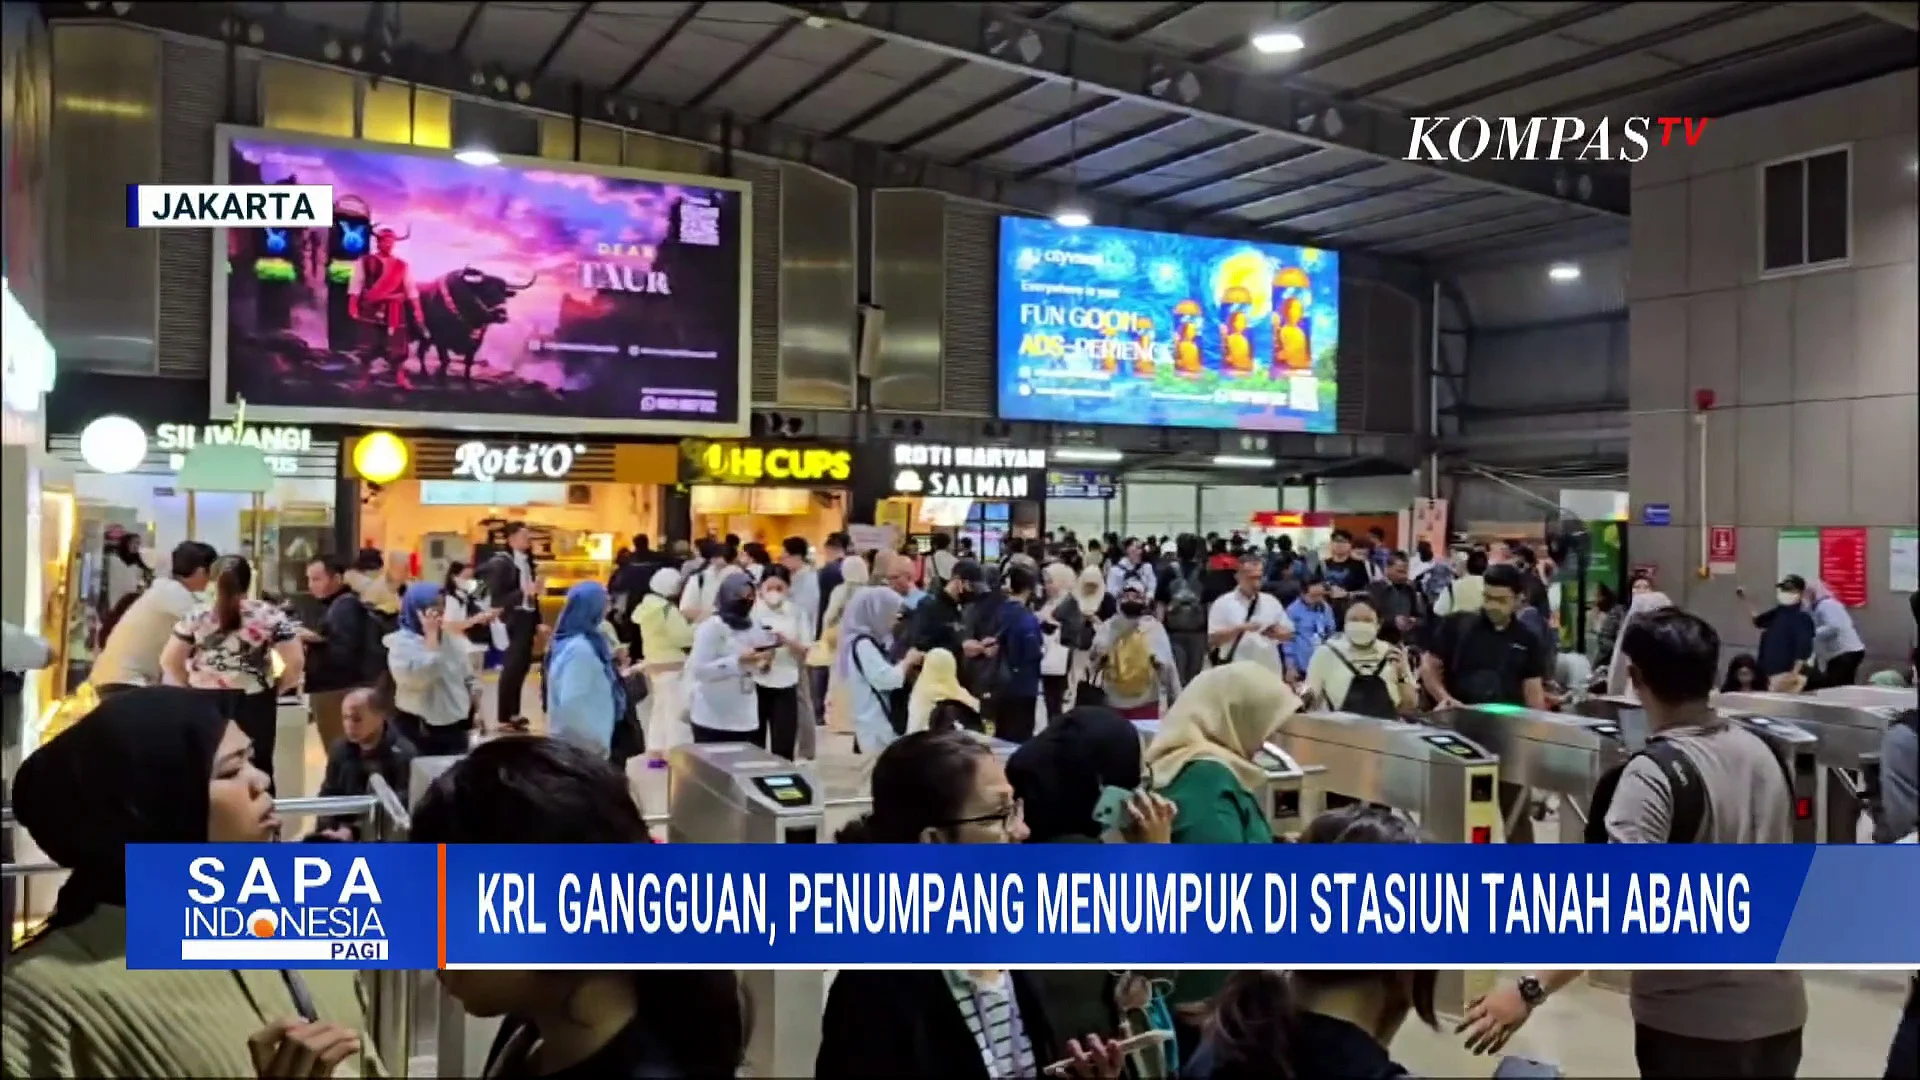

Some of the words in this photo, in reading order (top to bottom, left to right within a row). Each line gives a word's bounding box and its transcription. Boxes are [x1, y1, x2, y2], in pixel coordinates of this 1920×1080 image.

[1020, 303, 1065, 327] FUN
[731, 448, 763, 478] HI
[765, 449, 851, 479] CUPS
[895, 444, 951, 466] ROTI
[929, 471, 1028, 497] SALMAN
